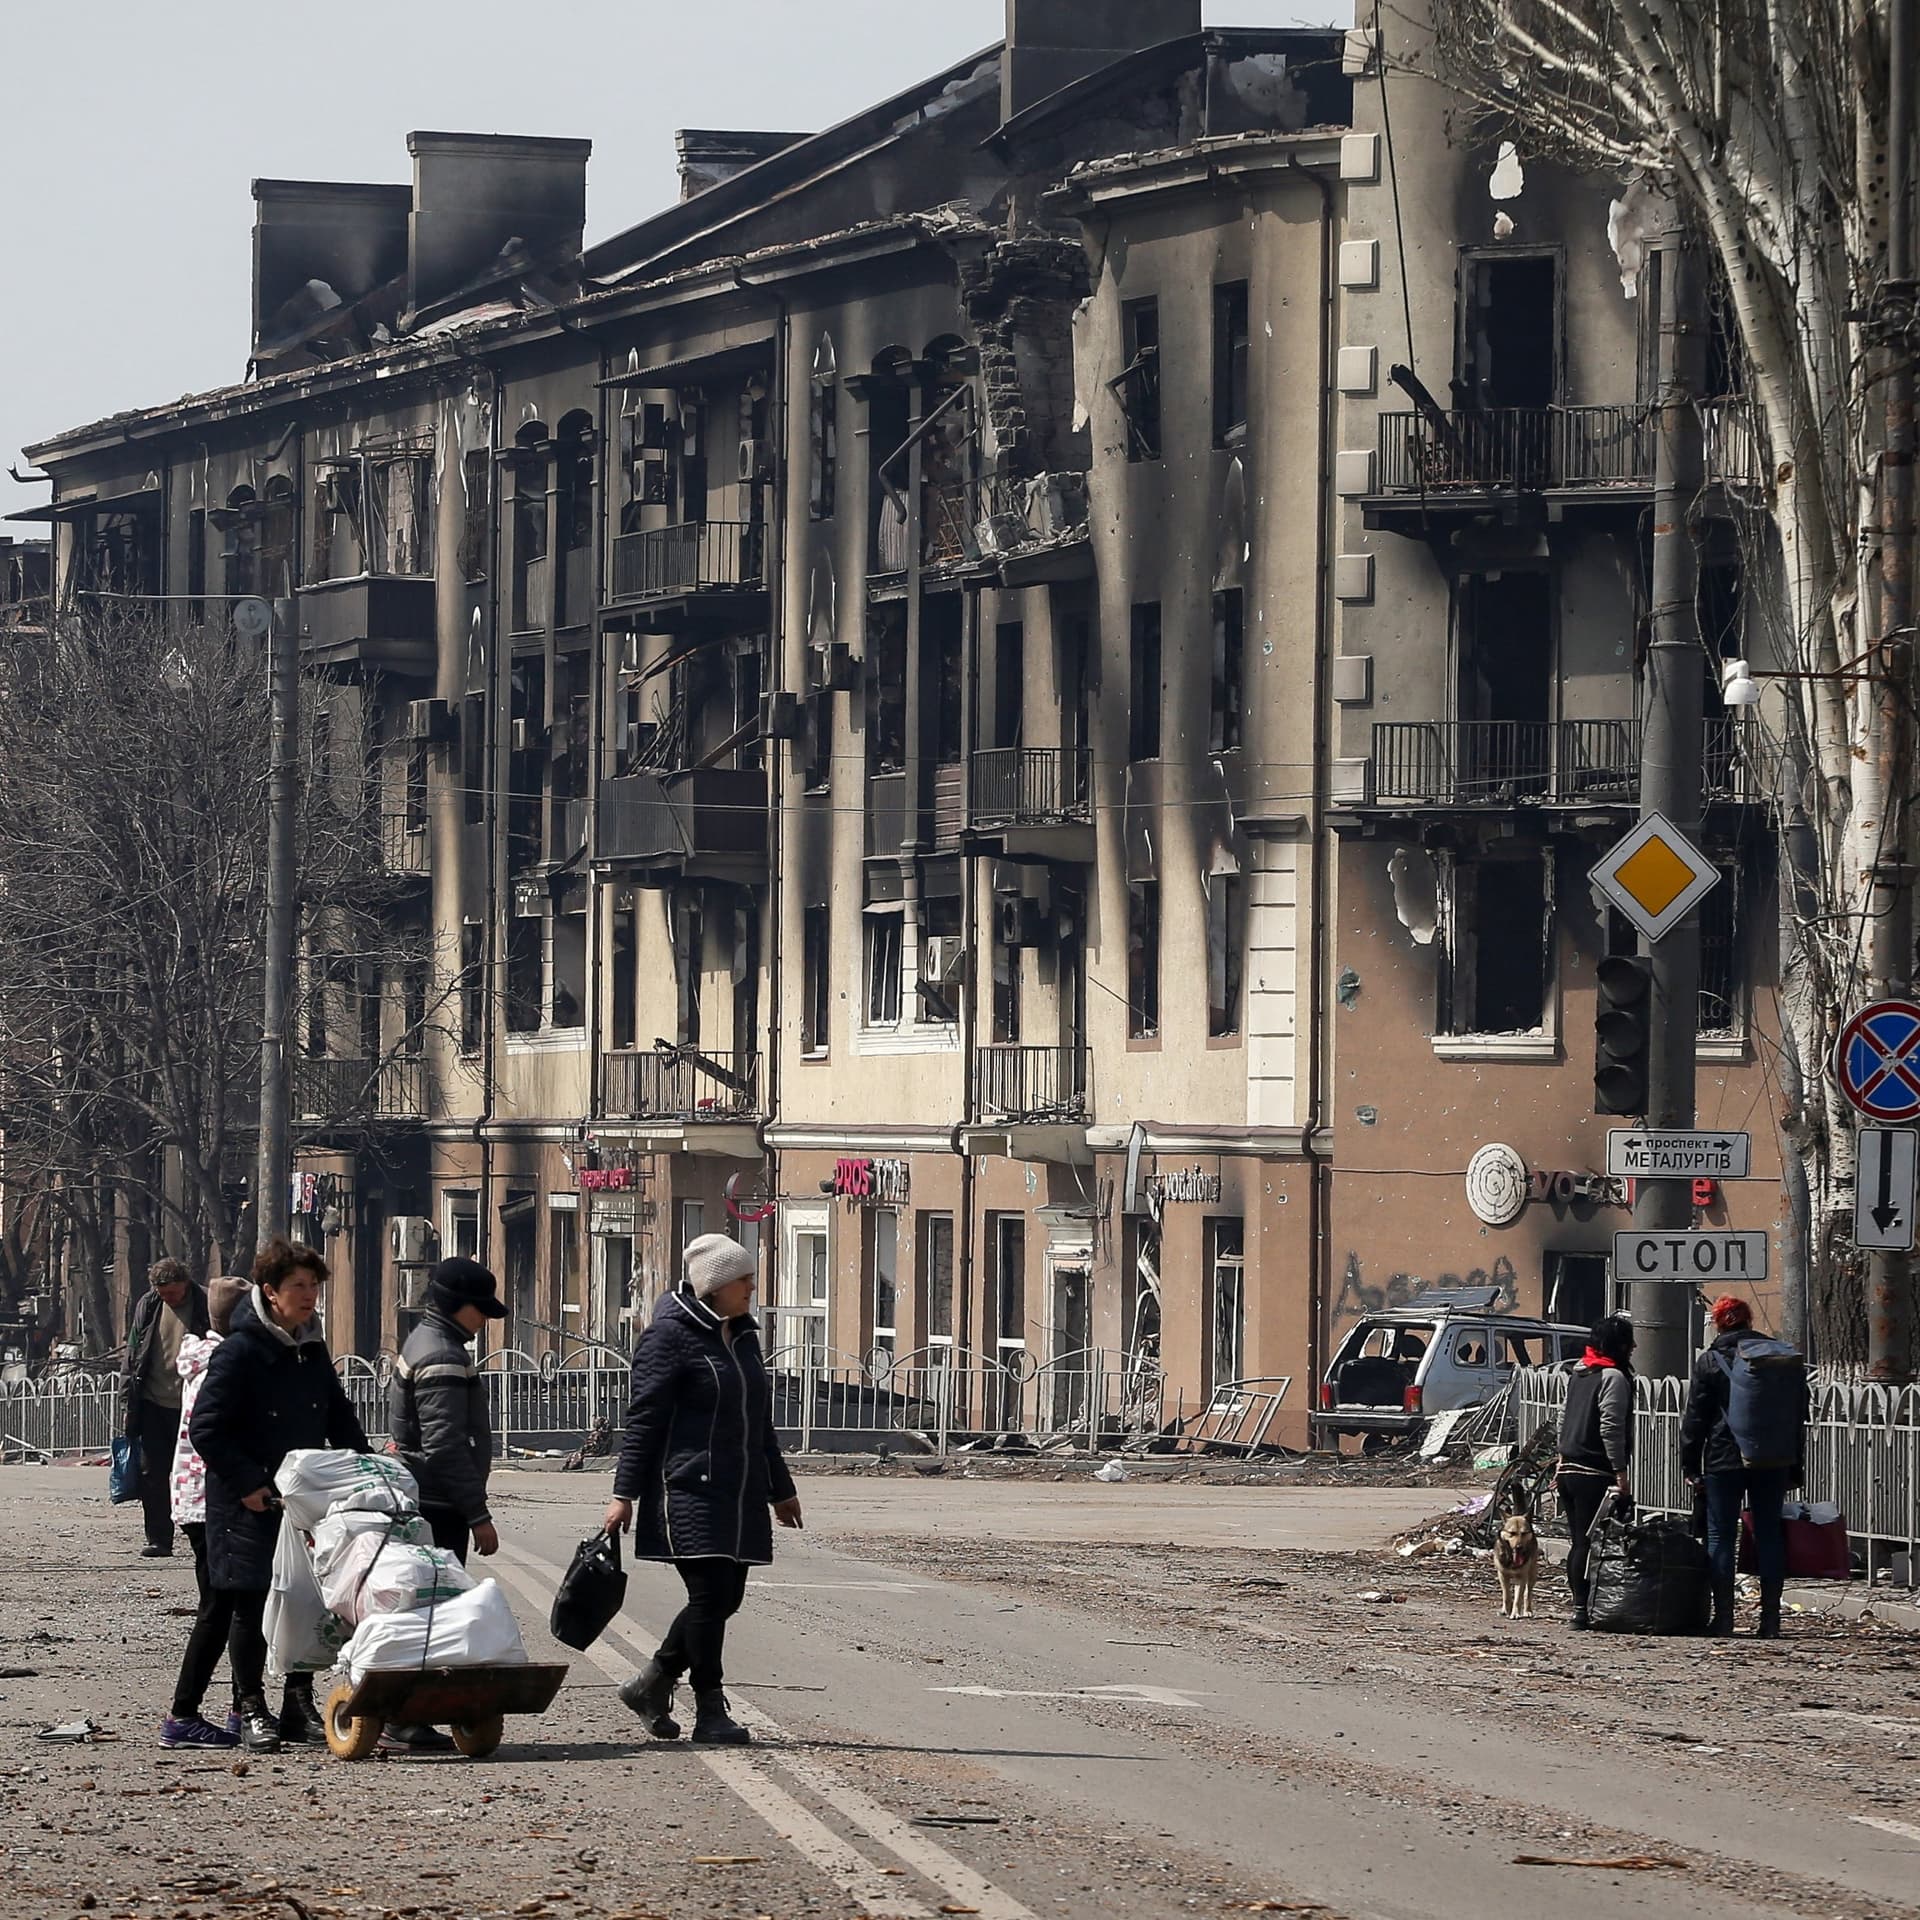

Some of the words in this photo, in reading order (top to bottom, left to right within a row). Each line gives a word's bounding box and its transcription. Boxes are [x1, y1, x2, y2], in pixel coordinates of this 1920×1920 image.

[1646, 1138, 1710, 1150] проспект
[1624, 1151, 1731, 1170] МЕТАЛУРГІВ
[1636, 1239, 1746, 1273] СТОП
